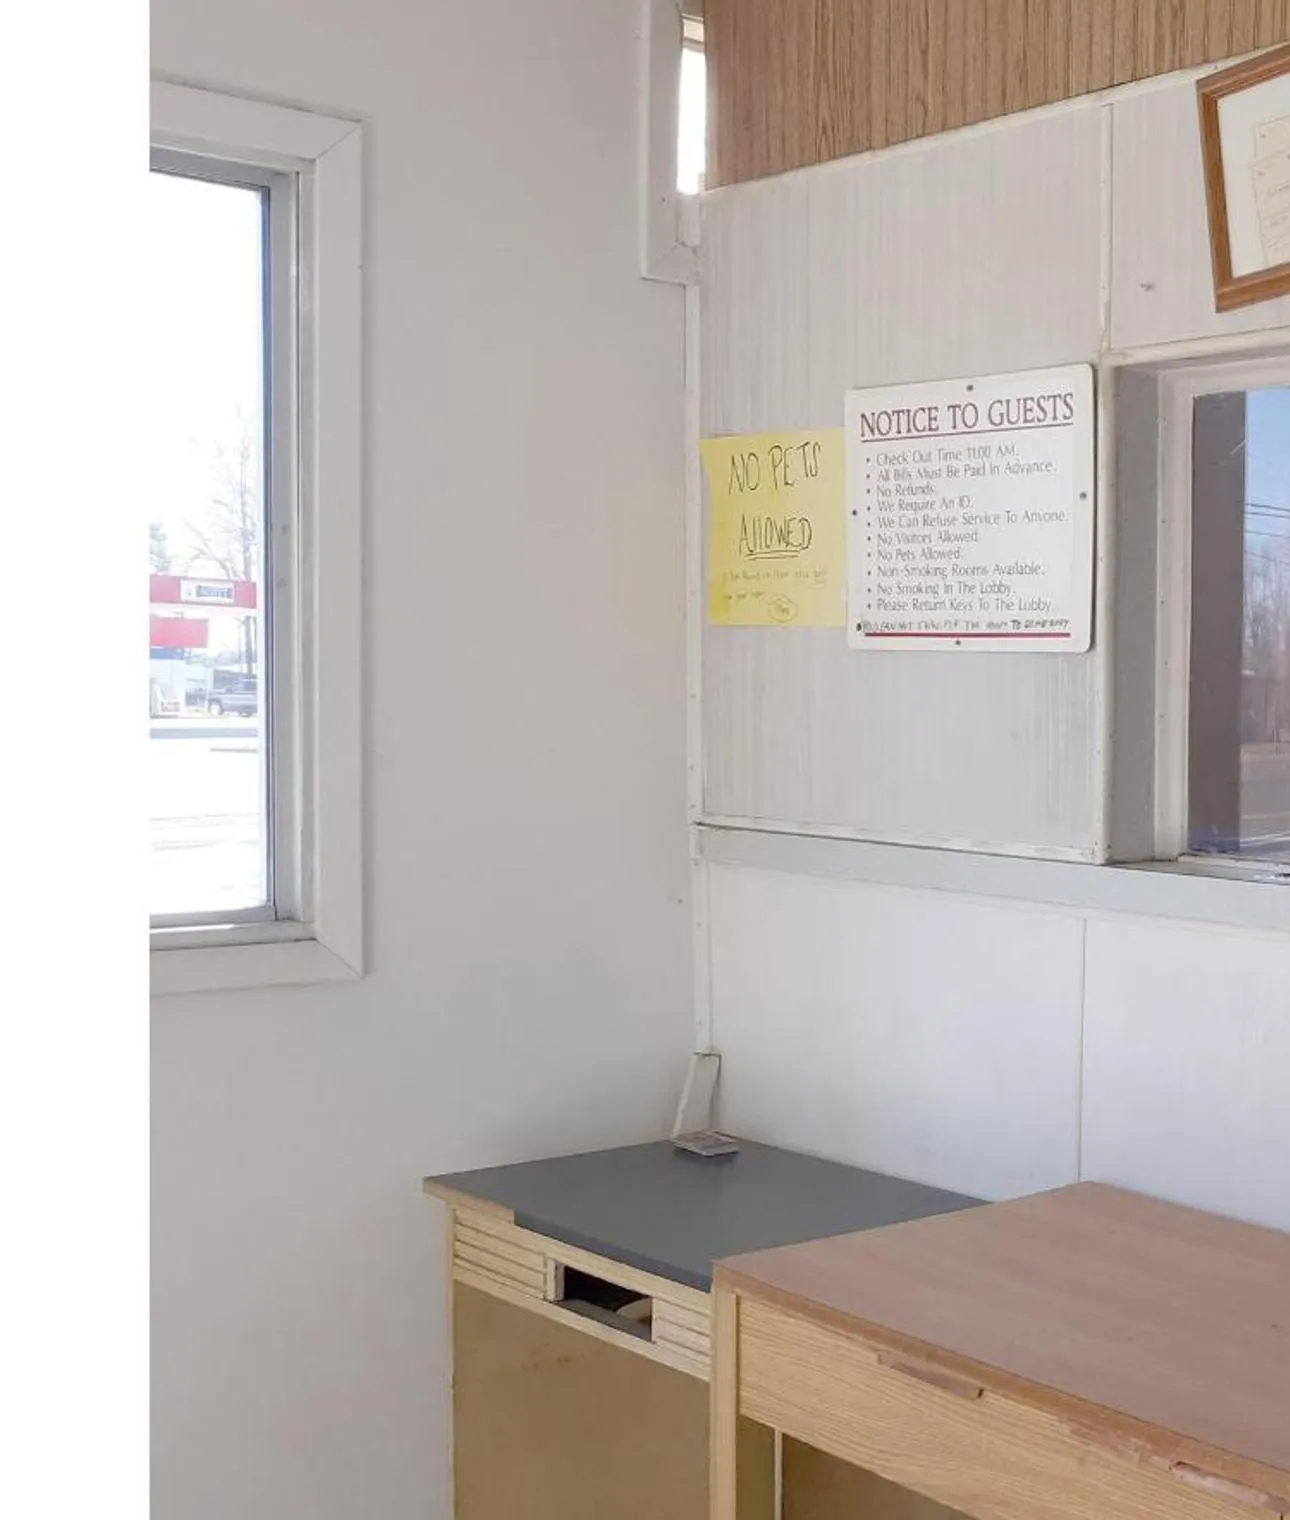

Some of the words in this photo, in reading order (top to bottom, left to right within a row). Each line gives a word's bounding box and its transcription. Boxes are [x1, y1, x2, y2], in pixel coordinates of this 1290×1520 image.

[860, 406, 939, 438] NOTICE
[947, 402, 979, 430] TO
[988, 392, 1074, 426] GUESTS
[877, 451, 908, 466] Check
[913, 449, 932, 463] Out
[938, 447, 962, 462] Time
[728, 452, 761, 495] NO
[768, 441, 821, 490] PETS
[878, 468, 889, 481] All
[894, 467, 912, 481] Bills
[917, 466, 942, 480] Must
[947, 464, 960, 478] Be
[964, 462, 986, 478] Paid
[990, 462, 1000, 476] In
[877, 484, 891, 497] No
[878, 499, 895, 512] We
[899, 497, 936, 515] Require
[941, 497, 955, 510] An
[878, 516, 895, 528] We
[899, 514, 919, 528] Can
[923, 513, 958, 527] Refuse
[962, 512, 1000, 526] Service
[1005, 510, 1017, 523] To
[877, 534, 891, 546] No
[896, 532, 932, 544] Visitors
[877, 551, 892, 562] No
[896, 549, 916, 562] Pets
[952, 564, 988, 576] Rooms
[877, 583, 892, 595] No
[896, 582, 939, 596] Smoking
[943, 582, 953, 594] In
[957, 581, 975, 594] The
[877, 599, 908, 611] Please
[912, 599, 946, 611] Return
[950, 599, 973, 613] Keys
[978, 599, 989, 611] To
[995, 598, 1014, 611] The
